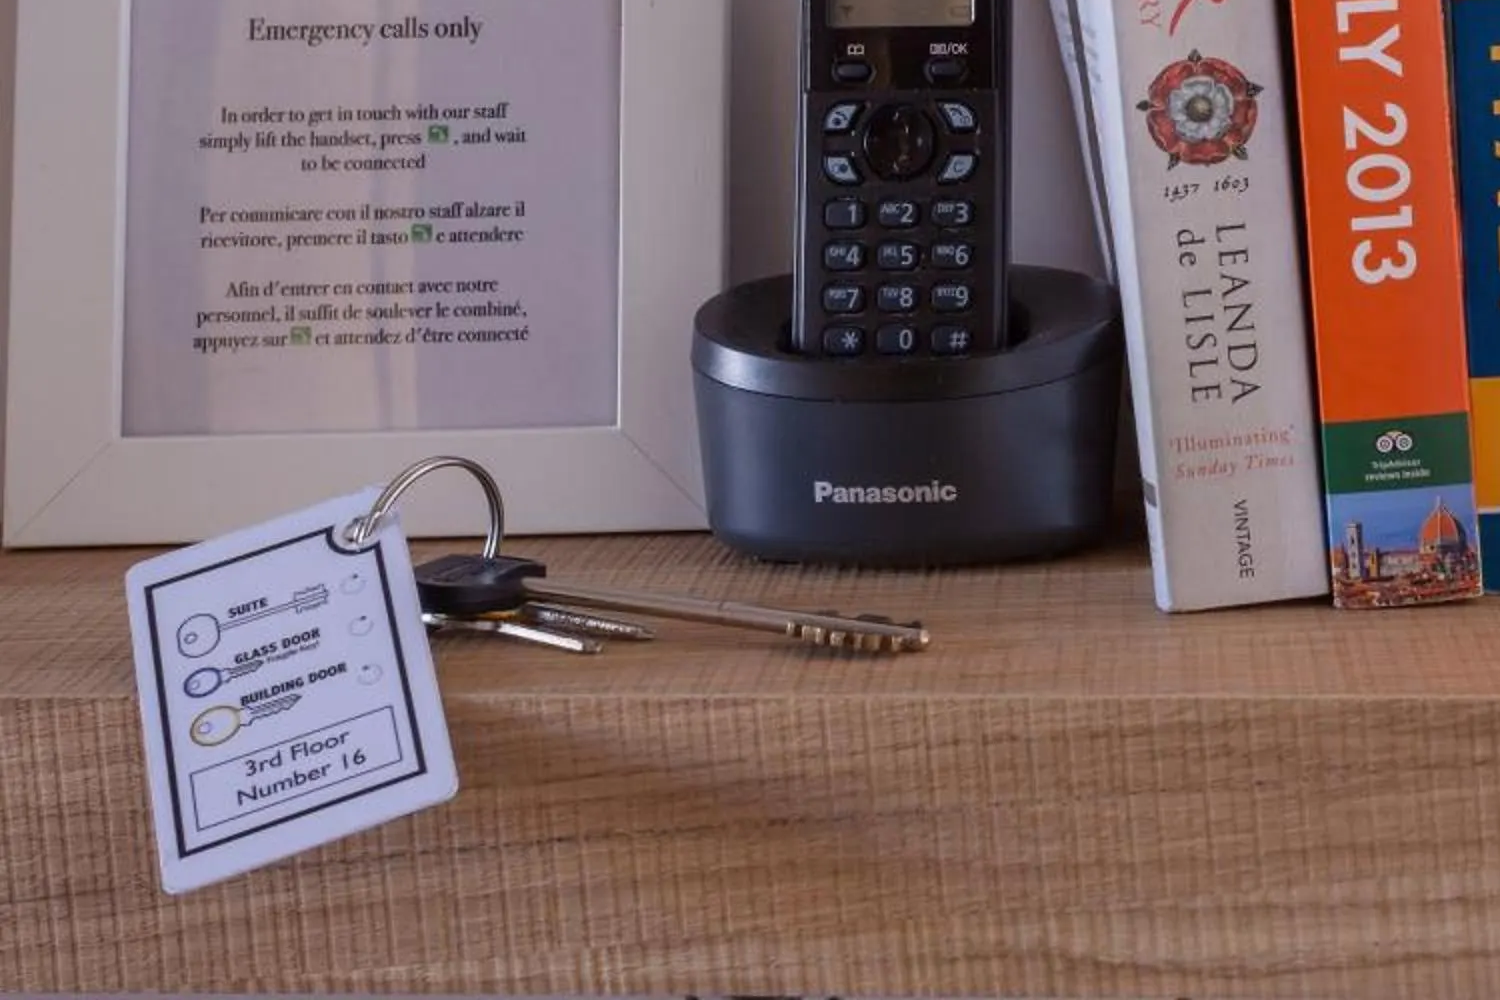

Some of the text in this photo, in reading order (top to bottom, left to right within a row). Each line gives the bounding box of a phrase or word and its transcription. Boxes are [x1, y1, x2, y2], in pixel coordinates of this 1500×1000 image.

[249, 16, 483, 46] Emergency calls only
[221, 102, 509, 126] In order to get in touch with our staff
[200, 132, 250, 152] simply
[255, 131, 276, 147] lift
[281, 132, 305, 147] the
[310, 130, 376, 147] handset,
[380, 133, 421, 150] press
[462, 128, 491, 143] and
[494, 128, 526, 143] wait
[301, 154, 426, 171] to be connected
[1214, 175, 1250, 193] 1603
[1342, 102, 1418, 286] 2013
[200, 206, 227, 224] Per
[326, 208, 356, 221] con
[360, 204, 370, 220] il
[374, 206, 425, 220] nostro
[429, 202, 464, 218] staff
[466, 202, 511, 218] alzare
[515, 201, 525, 217] il
[848, 204, 857, 224] 1
[900, 203, 913, 223] 2
[955, 203, 969, 223] 3
[286, 233, 352, 251] premere
[356, 229, 367, 244] il
[371, 230, 409, 245] tasto
[436, 231, 445, 243] e
[449, 226, 525, 243] attendere
[846, 245, 860, 266] 4
[901, 245, 913, 265] 5
[955, 245, 969, 265] 6
[225, 281, 259, 298] Afin
[333, 283, 353, 296] en
[356, 281, 414, 295] contact
[418, 281, 453, 294] avec
[456, 279, 499, 293] notre
[847, 289, 859, 309] 7
[900, 288, 913, 308] 8
[955, 286, 969, 307] 9
[284, 305, 295, 321] il
[299, 304, 339, 321] suffit
[343, 304, 363, 320] de
[365, 303, 432, 320] soulever
[436, 302, 450, 318] le
[1176, 228, 1223, 403] de LISLE
[1215, 222, 1261, 406] LEANDA
[193, 335, 257, 354] appuyez
[262, 335, 288, 347] sur
[315, 334, 330, 345] et
[333, 328, 401, 346] attendez
[457, 326, 529, 342] connecté
[899, 329, 913, 350] 0
[1174, 454, 1294, 479] Sunday Times
[813, 480, 959, 503] Panasonic
[1233, 499, 1255, 579] VINTAGE
[228, 597, 269, 619] SUITE
[234, 641, 277, 664] GLASS
[281, 627, 320, 649] DOOR
[240, 662, 347, 706] BUILDING DOOR
[244, 730, 350, 777] 3rd Floor
[236, 747, 366, 806] Number 16
